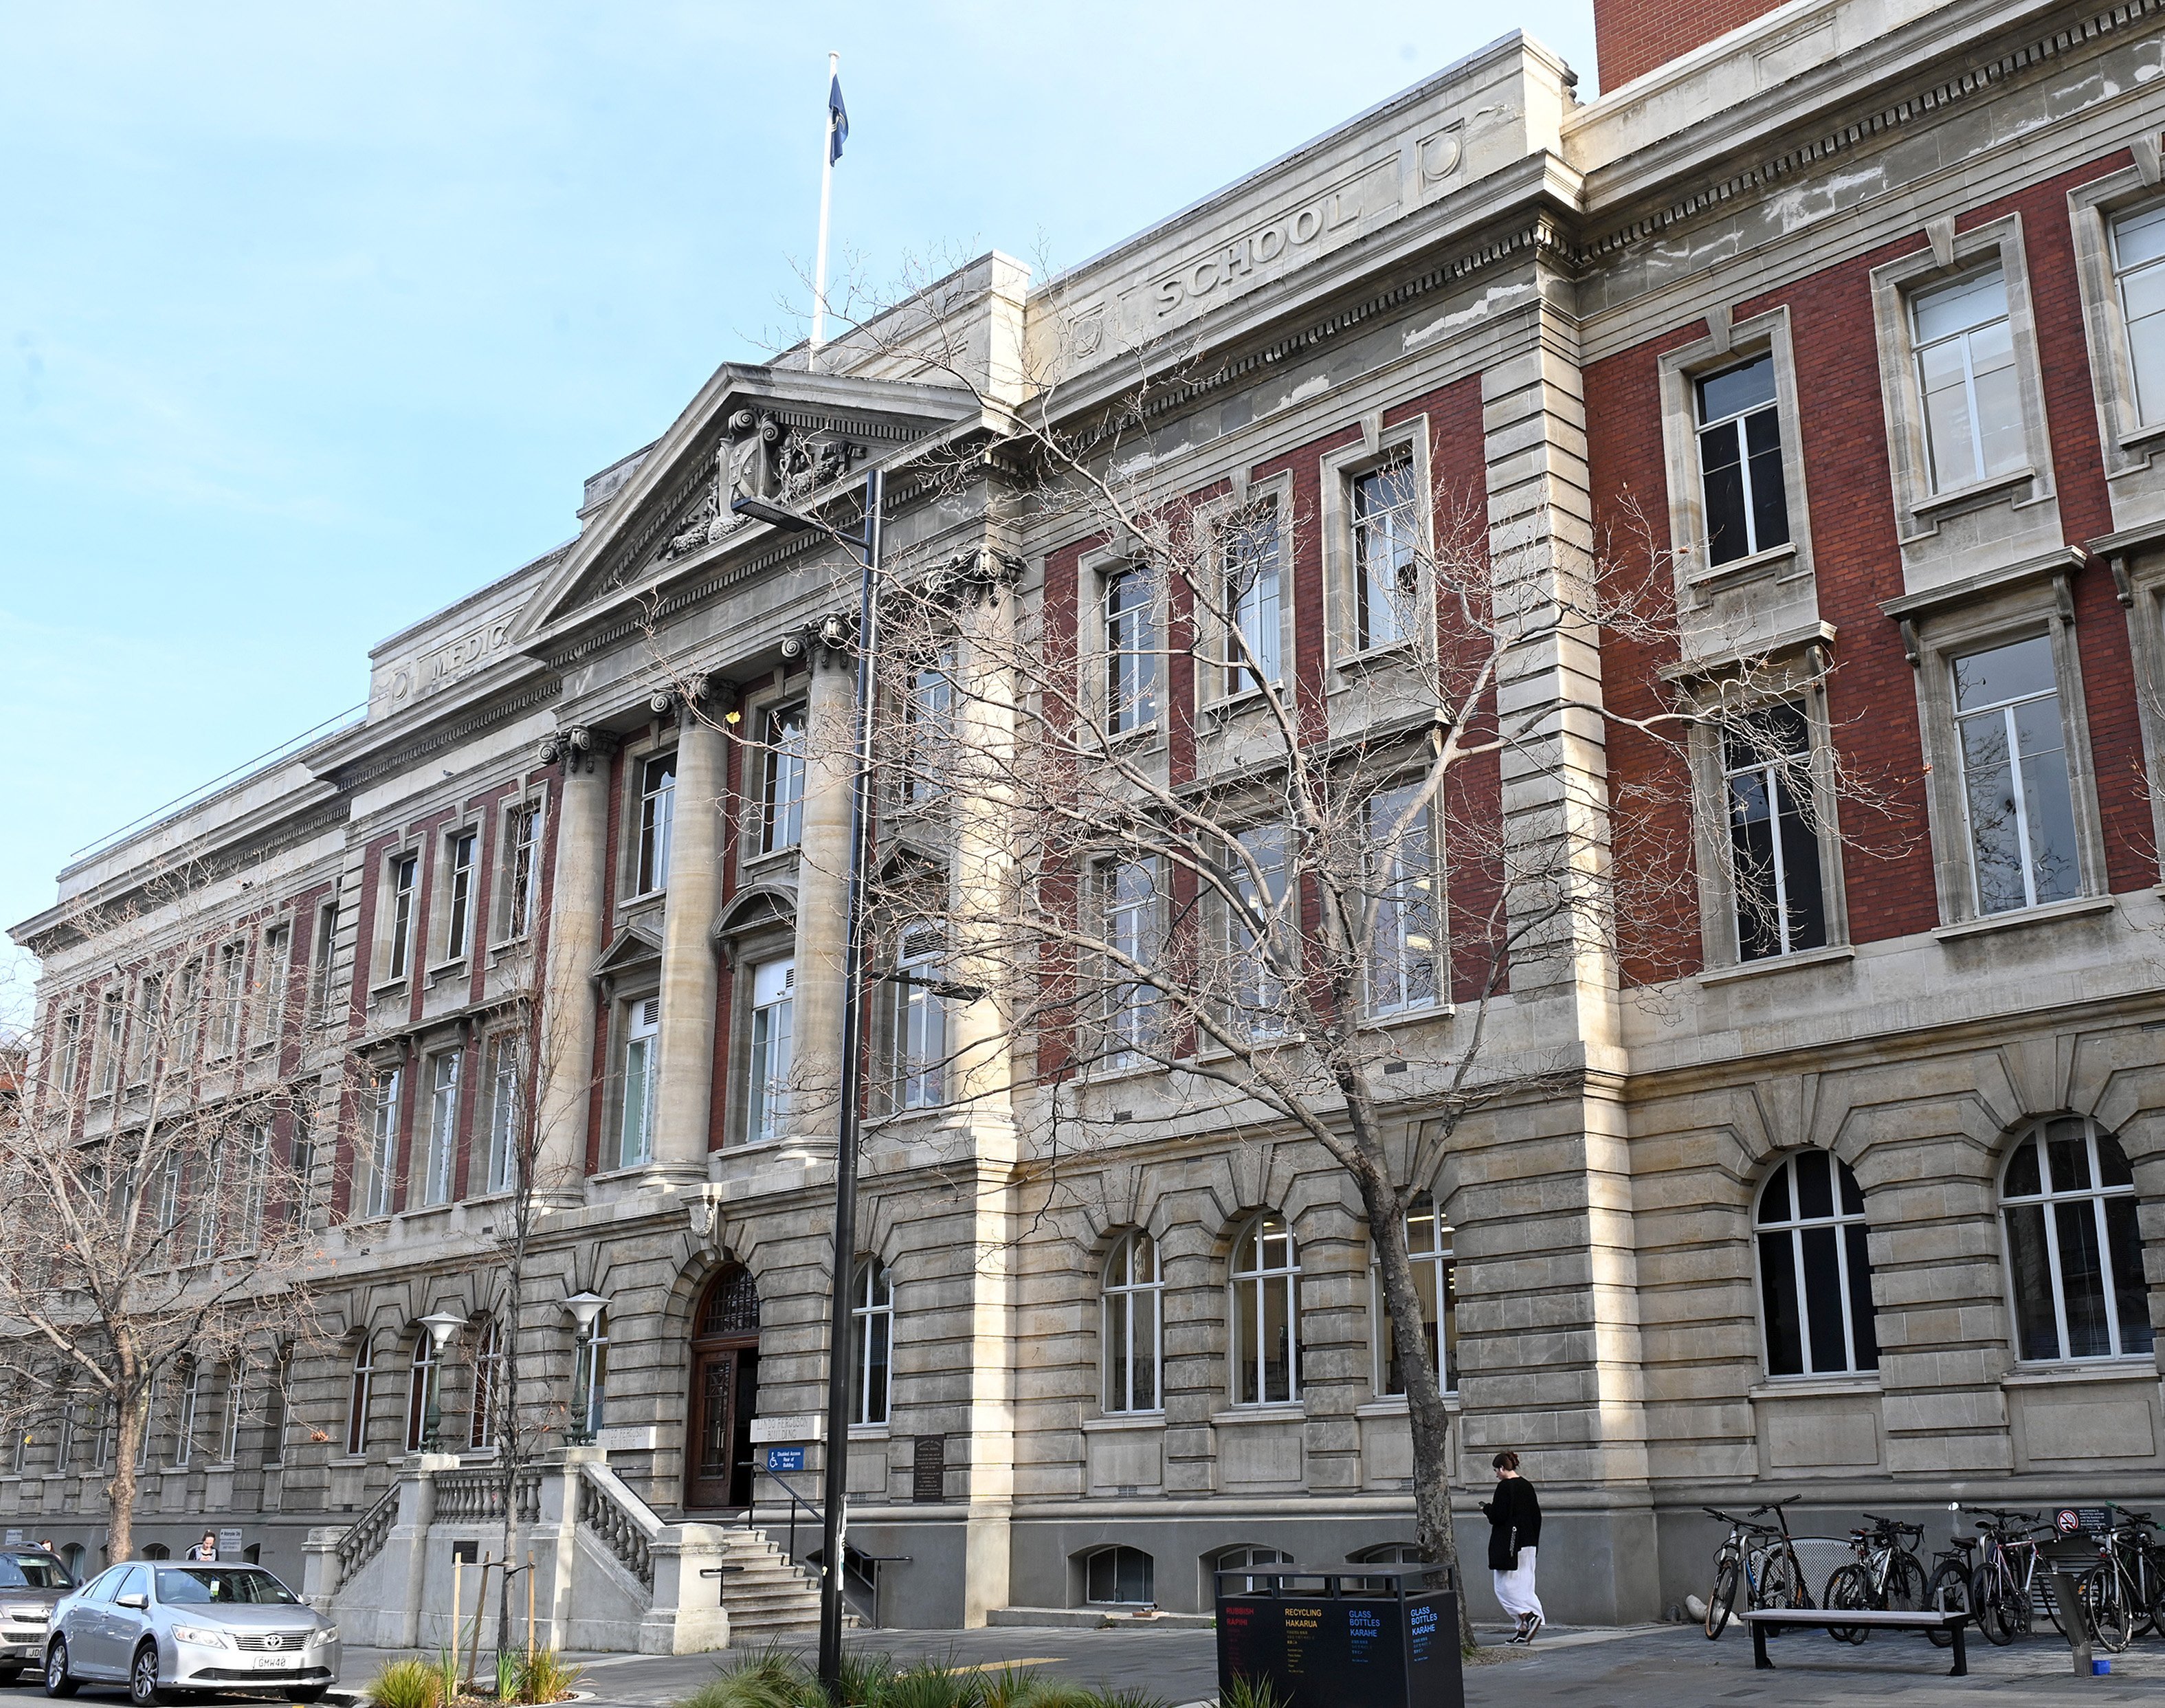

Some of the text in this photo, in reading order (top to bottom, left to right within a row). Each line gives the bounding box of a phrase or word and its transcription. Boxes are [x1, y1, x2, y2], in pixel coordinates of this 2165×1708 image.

[1156, 195, 1362, 317] SCHOOL
[757, 1417, 808, 1430] LINDO FERGUSON
[767, 1429, 797, 1440] BUILDING
[1225, 1607, 1254, 1615] RUBBISH
[1285, 1608, 1322, 1617] RECYCLING
[1348, 1610, 1371, 1618] GLASS
[1410, 1606, 1430, 1617] GLASS
[1285, 1619, 1318, 1628] HAKARUA
[1349, 1619, 1380, 1627] BOTTLES
[1411, 1613, 1438, 1626] BOTTLES
